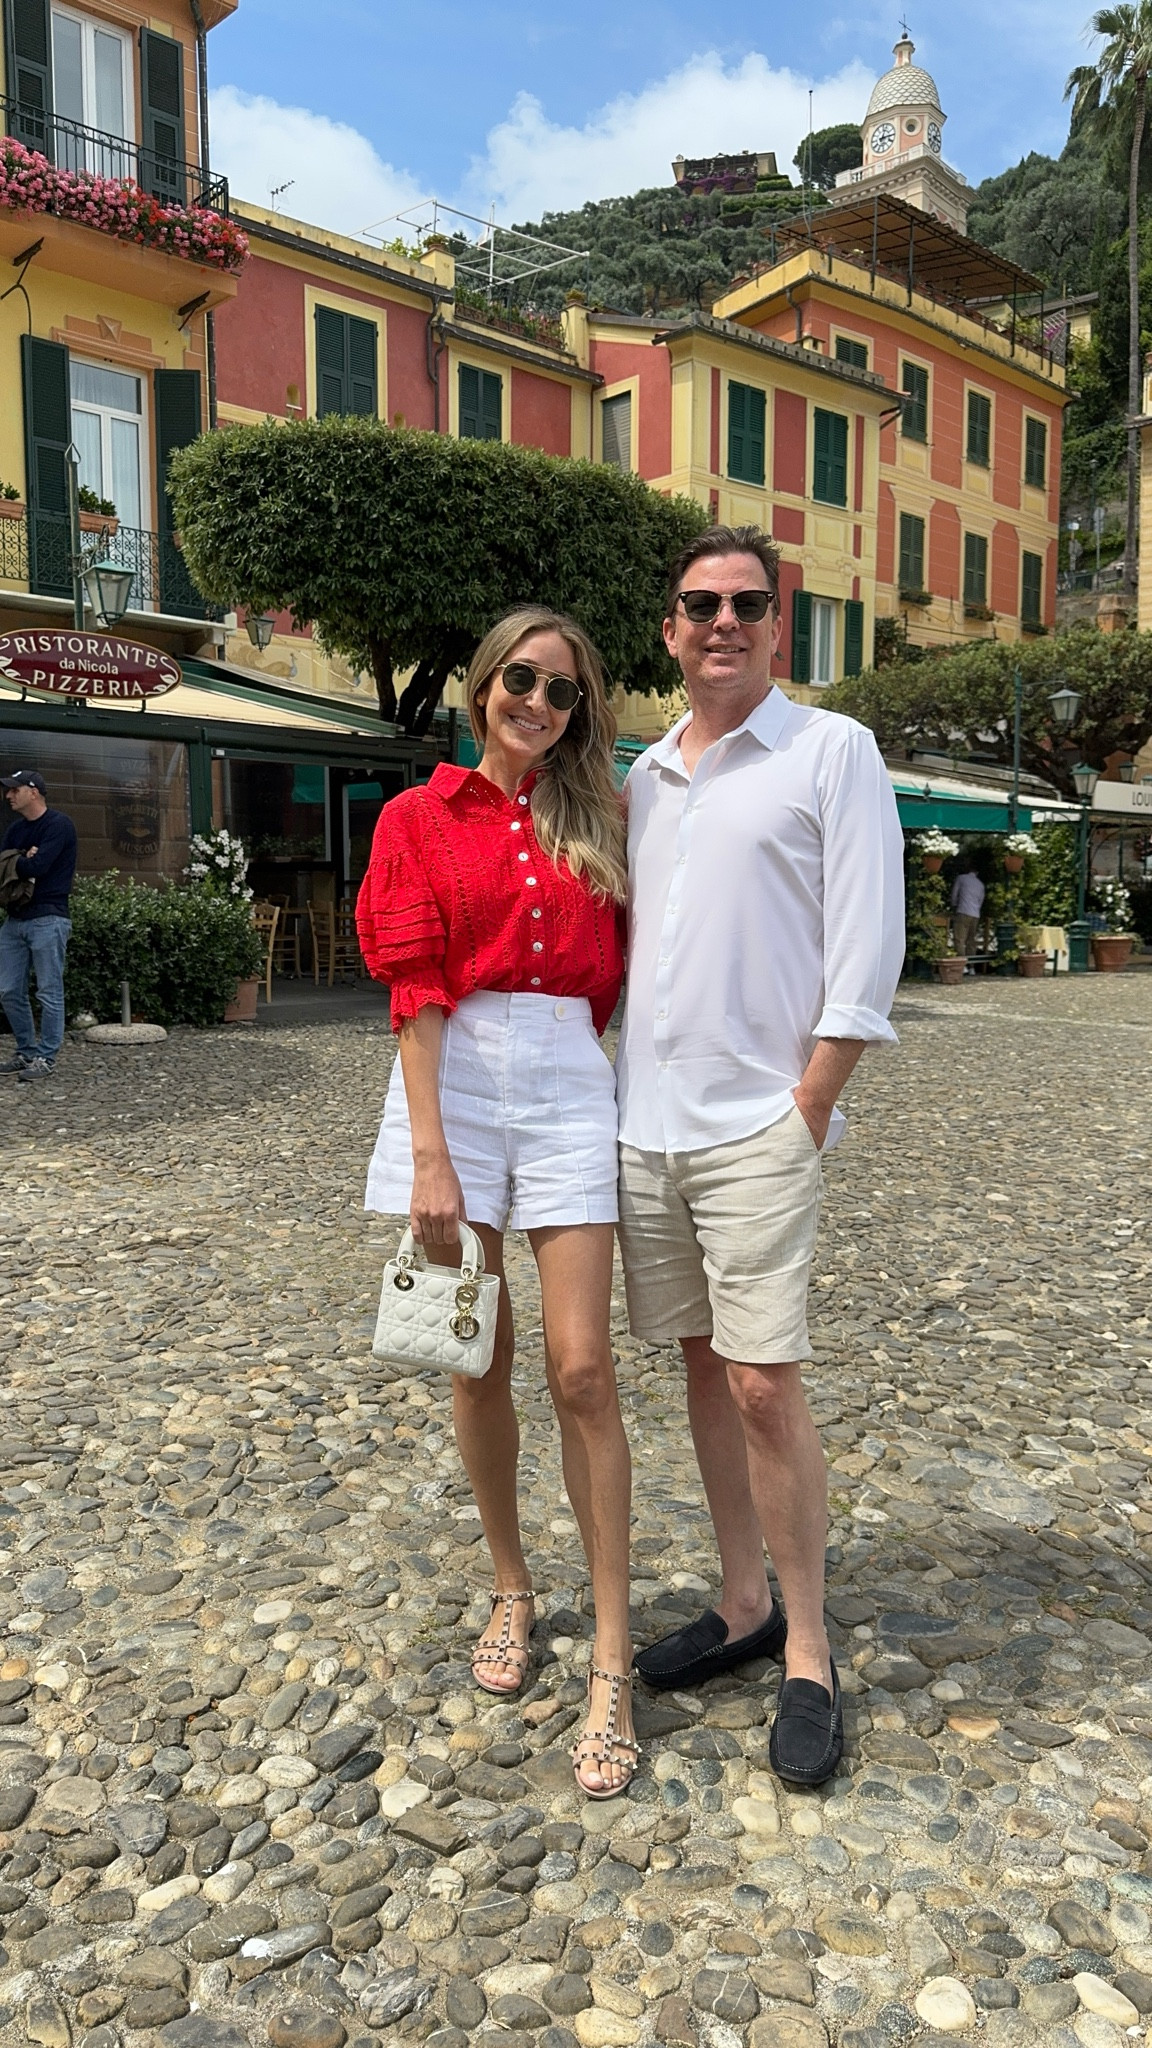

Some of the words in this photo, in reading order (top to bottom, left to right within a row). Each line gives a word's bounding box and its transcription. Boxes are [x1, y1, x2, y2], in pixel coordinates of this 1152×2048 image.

[14, 636, 157, 668] RISTORANTE
[59, 657, 75, 670] da
[78, 660, 119, 675] Nicola
[32, 670, 145, 697] PIZZERIA
